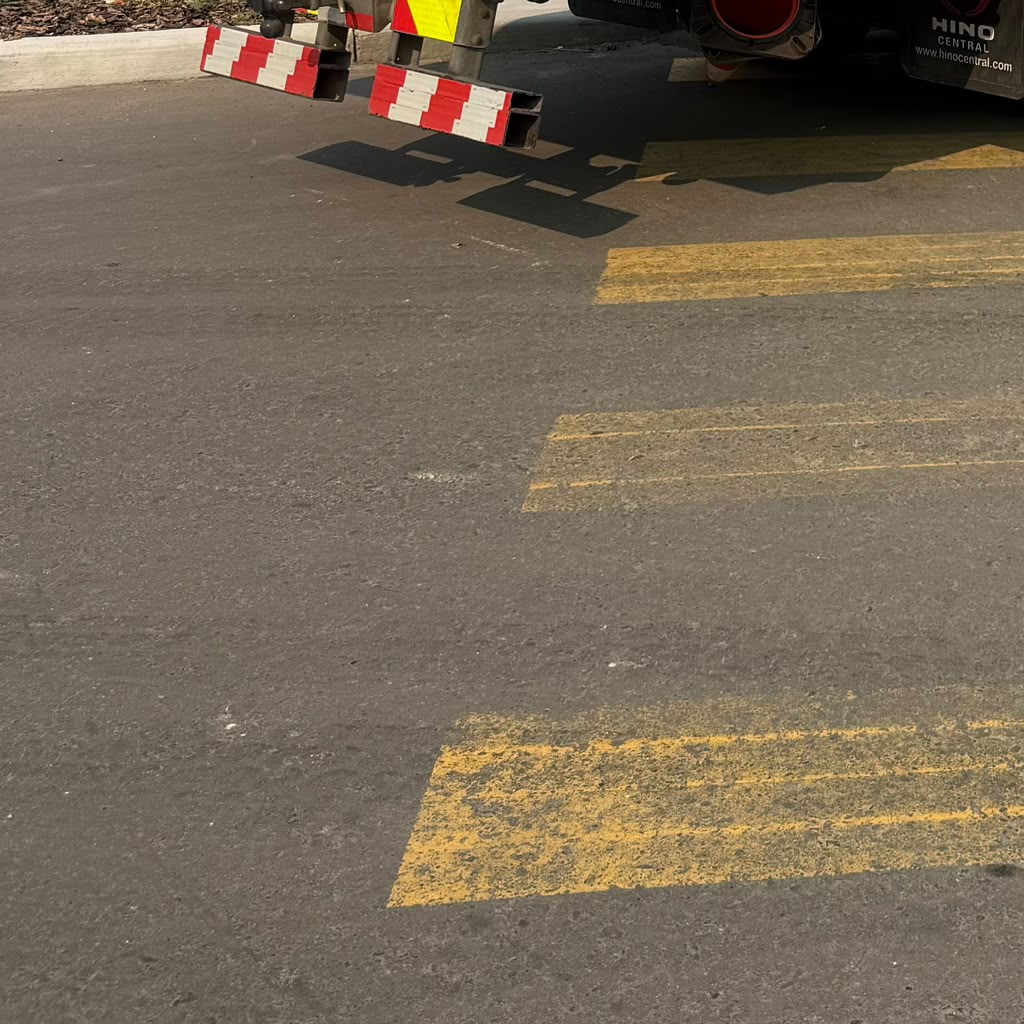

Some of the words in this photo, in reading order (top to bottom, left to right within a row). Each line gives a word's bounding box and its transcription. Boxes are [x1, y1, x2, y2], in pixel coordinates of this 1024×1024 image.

[931, 16, 995, 41] HINO
[937, 35, 989, 54] CENTRAL
[915, 45, 1013, 73] www.hinocentral.com
